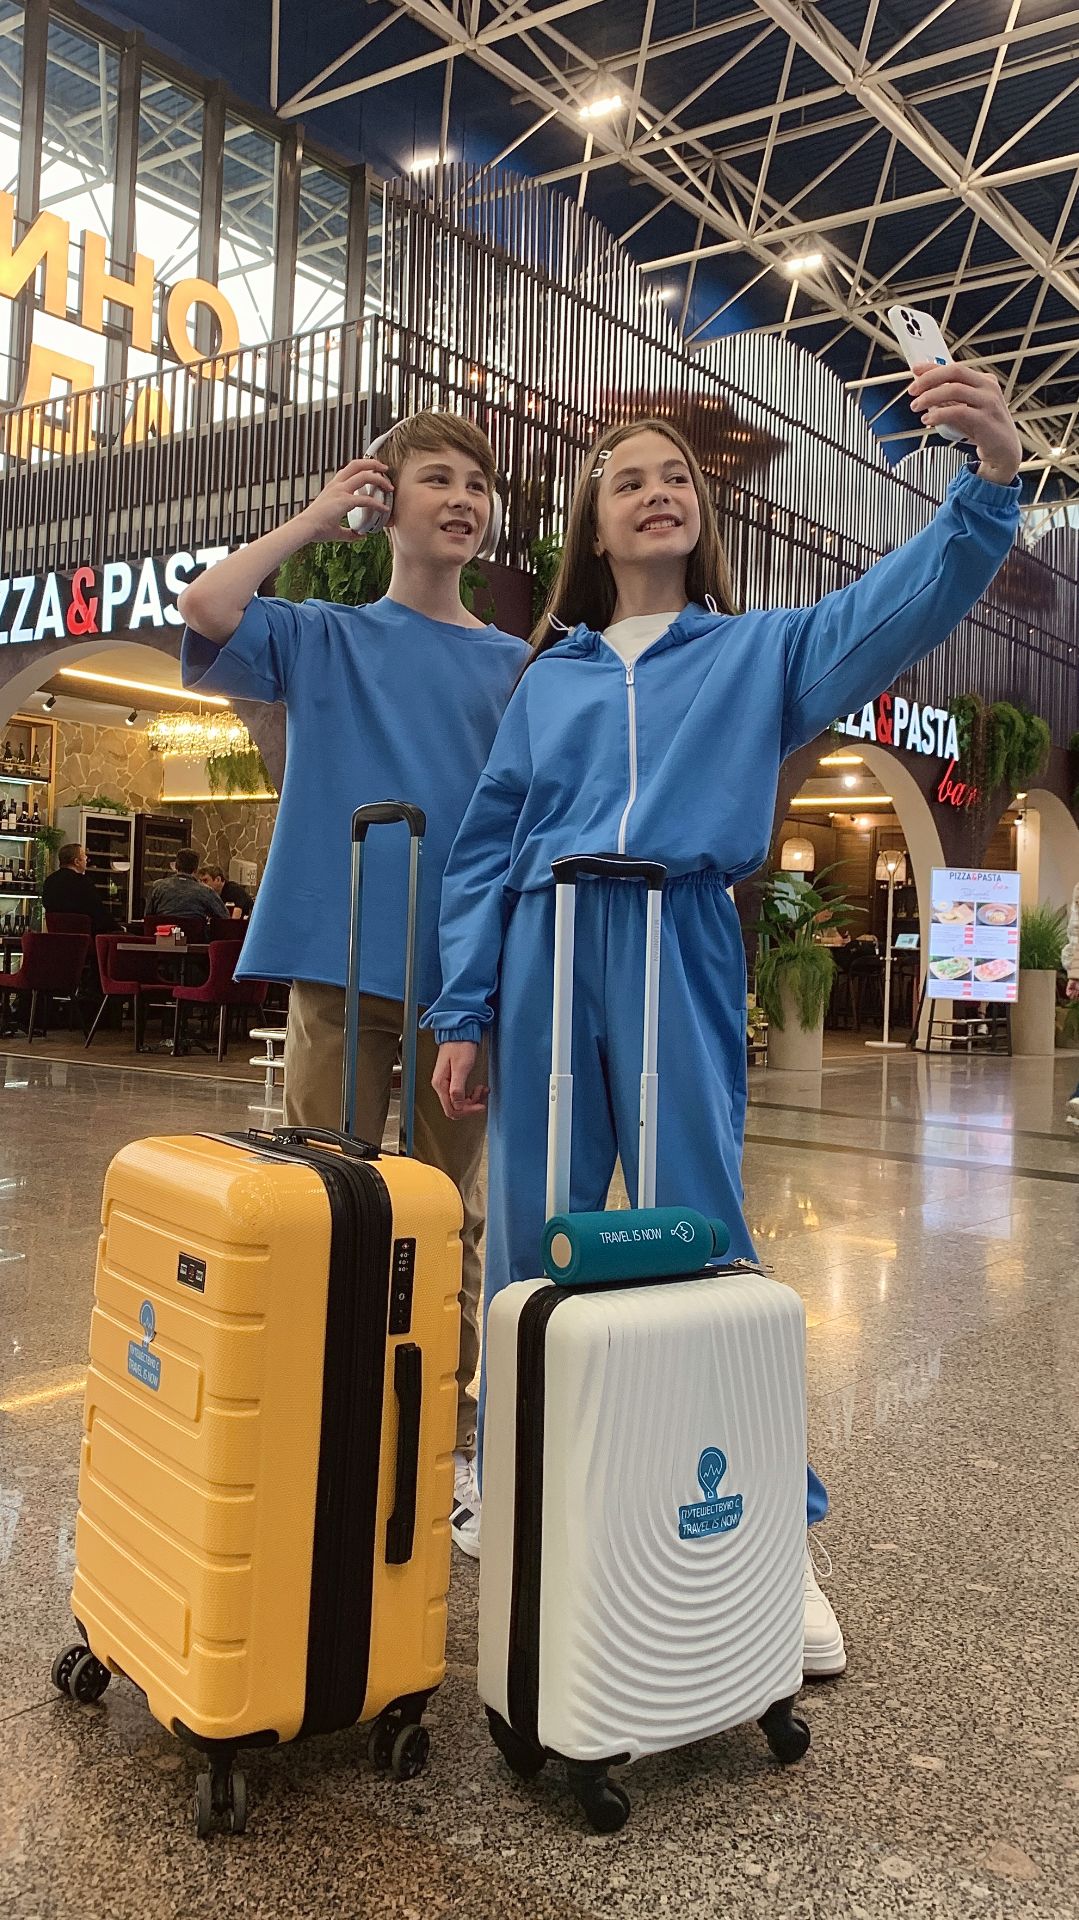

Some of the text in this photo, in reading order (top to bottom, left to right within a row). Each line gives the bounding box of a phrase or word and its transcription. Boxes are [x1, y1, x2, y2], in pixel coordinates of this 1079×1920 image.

[949, 871, 1002, 882] PIZZA&PASTA
[599, 1227, 662, 1244] TRAVEL IS NOW
[681, 1500, 734, 1520] ПУТЕШЕСТВУЮ
[683, 1512, 741, 1535] TRAVEL IS NOW
